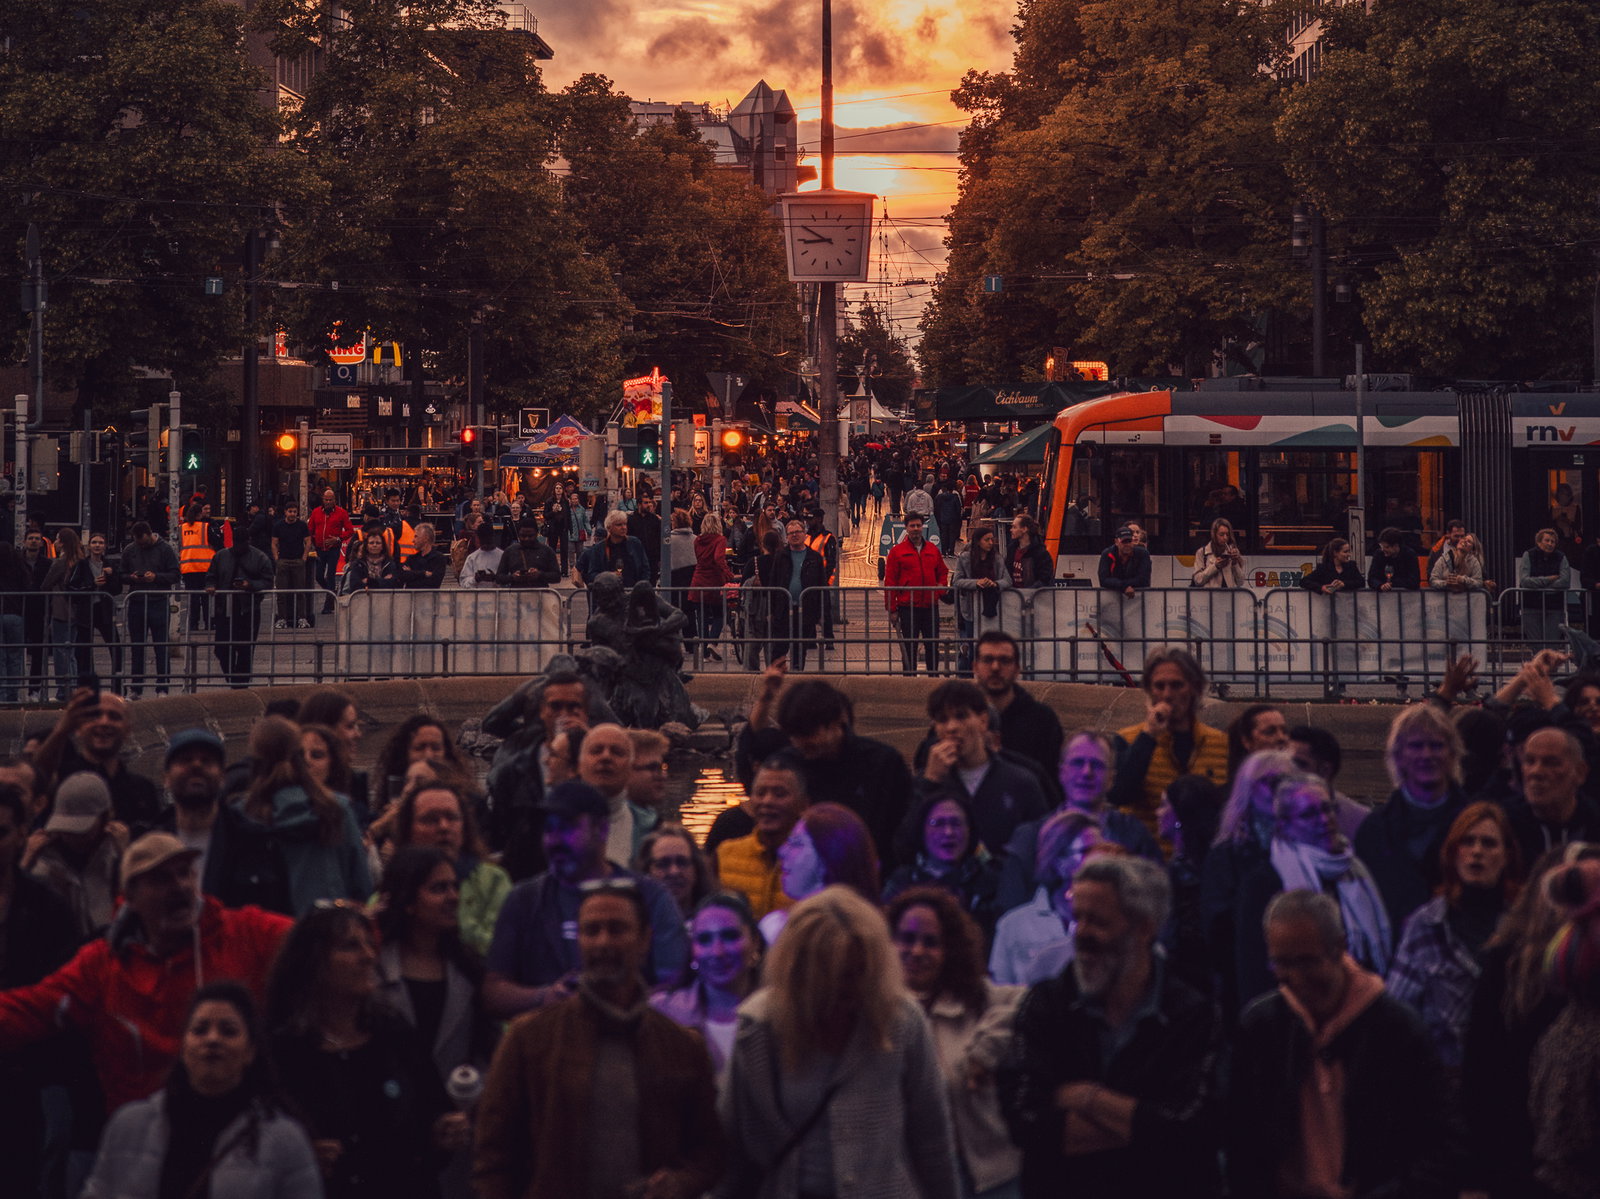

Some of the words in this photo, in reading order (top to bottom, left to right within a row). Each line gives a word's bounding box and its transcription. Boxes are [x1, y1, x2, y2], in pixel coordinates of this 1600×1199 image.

[995, 390, 1039, 405] Eichbaum
[1526, 426, 1576, 441] rnv
[1255, 571, 1303, 587] BABY
